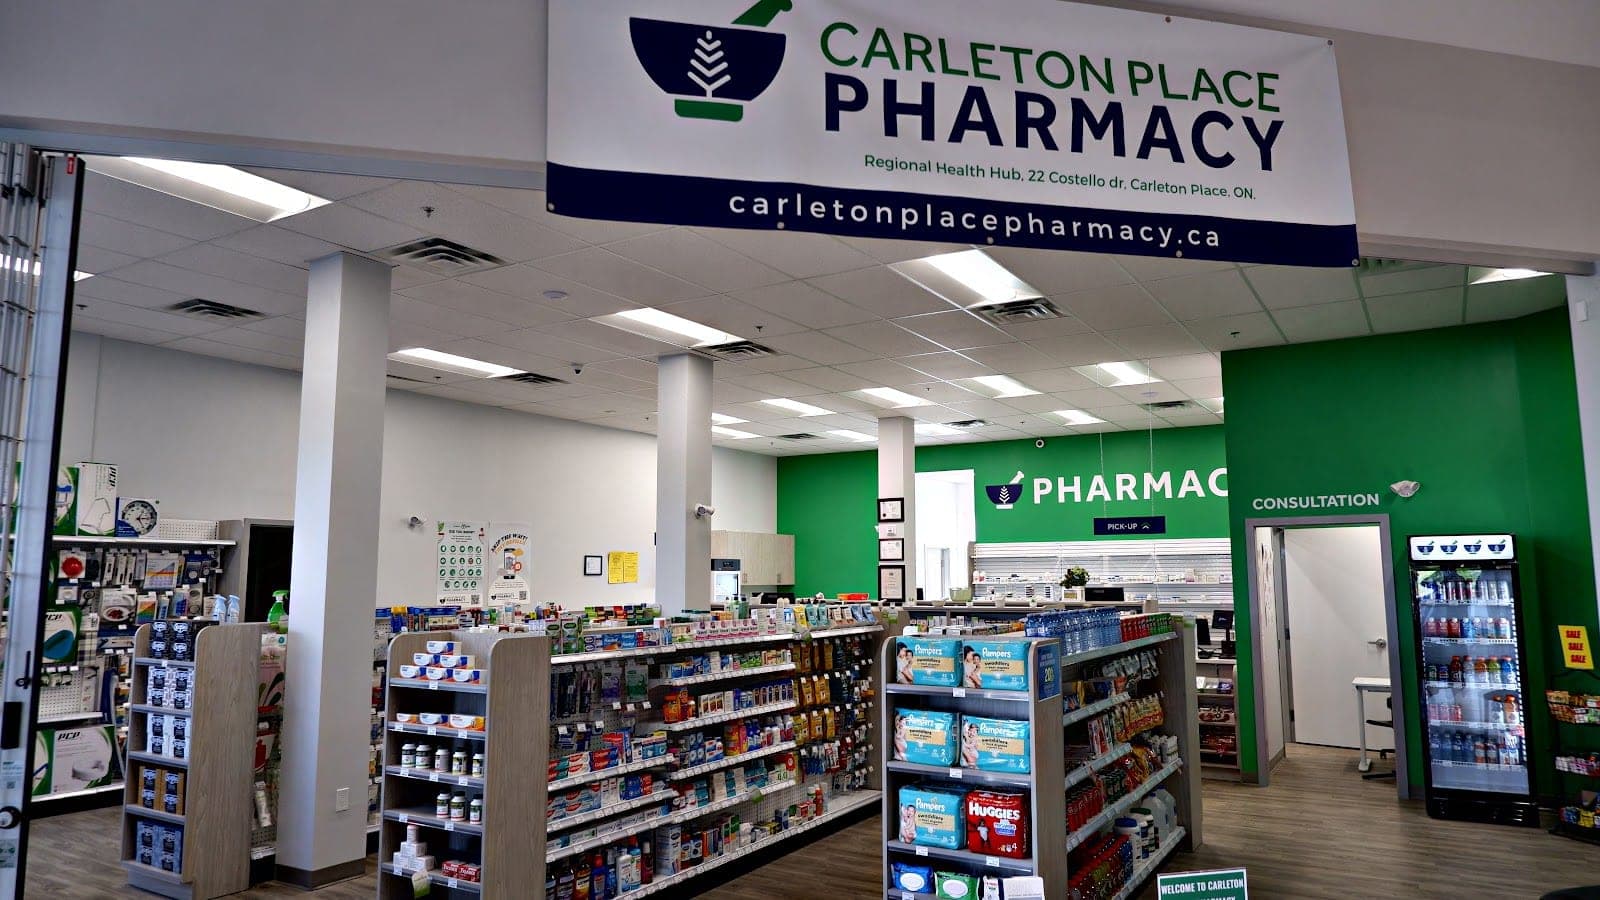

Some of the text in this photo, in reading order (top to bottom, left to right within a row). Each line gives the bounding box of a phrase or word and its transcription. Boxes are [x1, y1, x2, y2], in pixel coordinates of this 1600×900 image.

[820, 21, 1281, 113] CARLETON PLACE
[825, 71, 1285, 171] PHARMACY
[864, 154, 931, 175] Regional
[936, 161, 985, 179] Health
[1028, 169, 1045, 182] 22
[1048, 170, 1106, 188] Costello
[1130, 177, 1186, 195] Carleton
[729, 193, 1220, 248] carletonplacepharmacy.ca
[1252, 493, 1380, 510] CONSULTATION
[1107, 522, 1138, 531] PICK-UP
[1566, 630, 1581, 638] SALE
[982, 647, 1011, 658] Pampers
[1568, 642, 1583, 650] SALE
[1571, 655, 1586, 663] SALE
[916, 797, 946, 812] Pampers
[968, 800, 1021, 821] HUGGIES
[1160, 878, 1245, 895] WELCOME TO CARLETON
